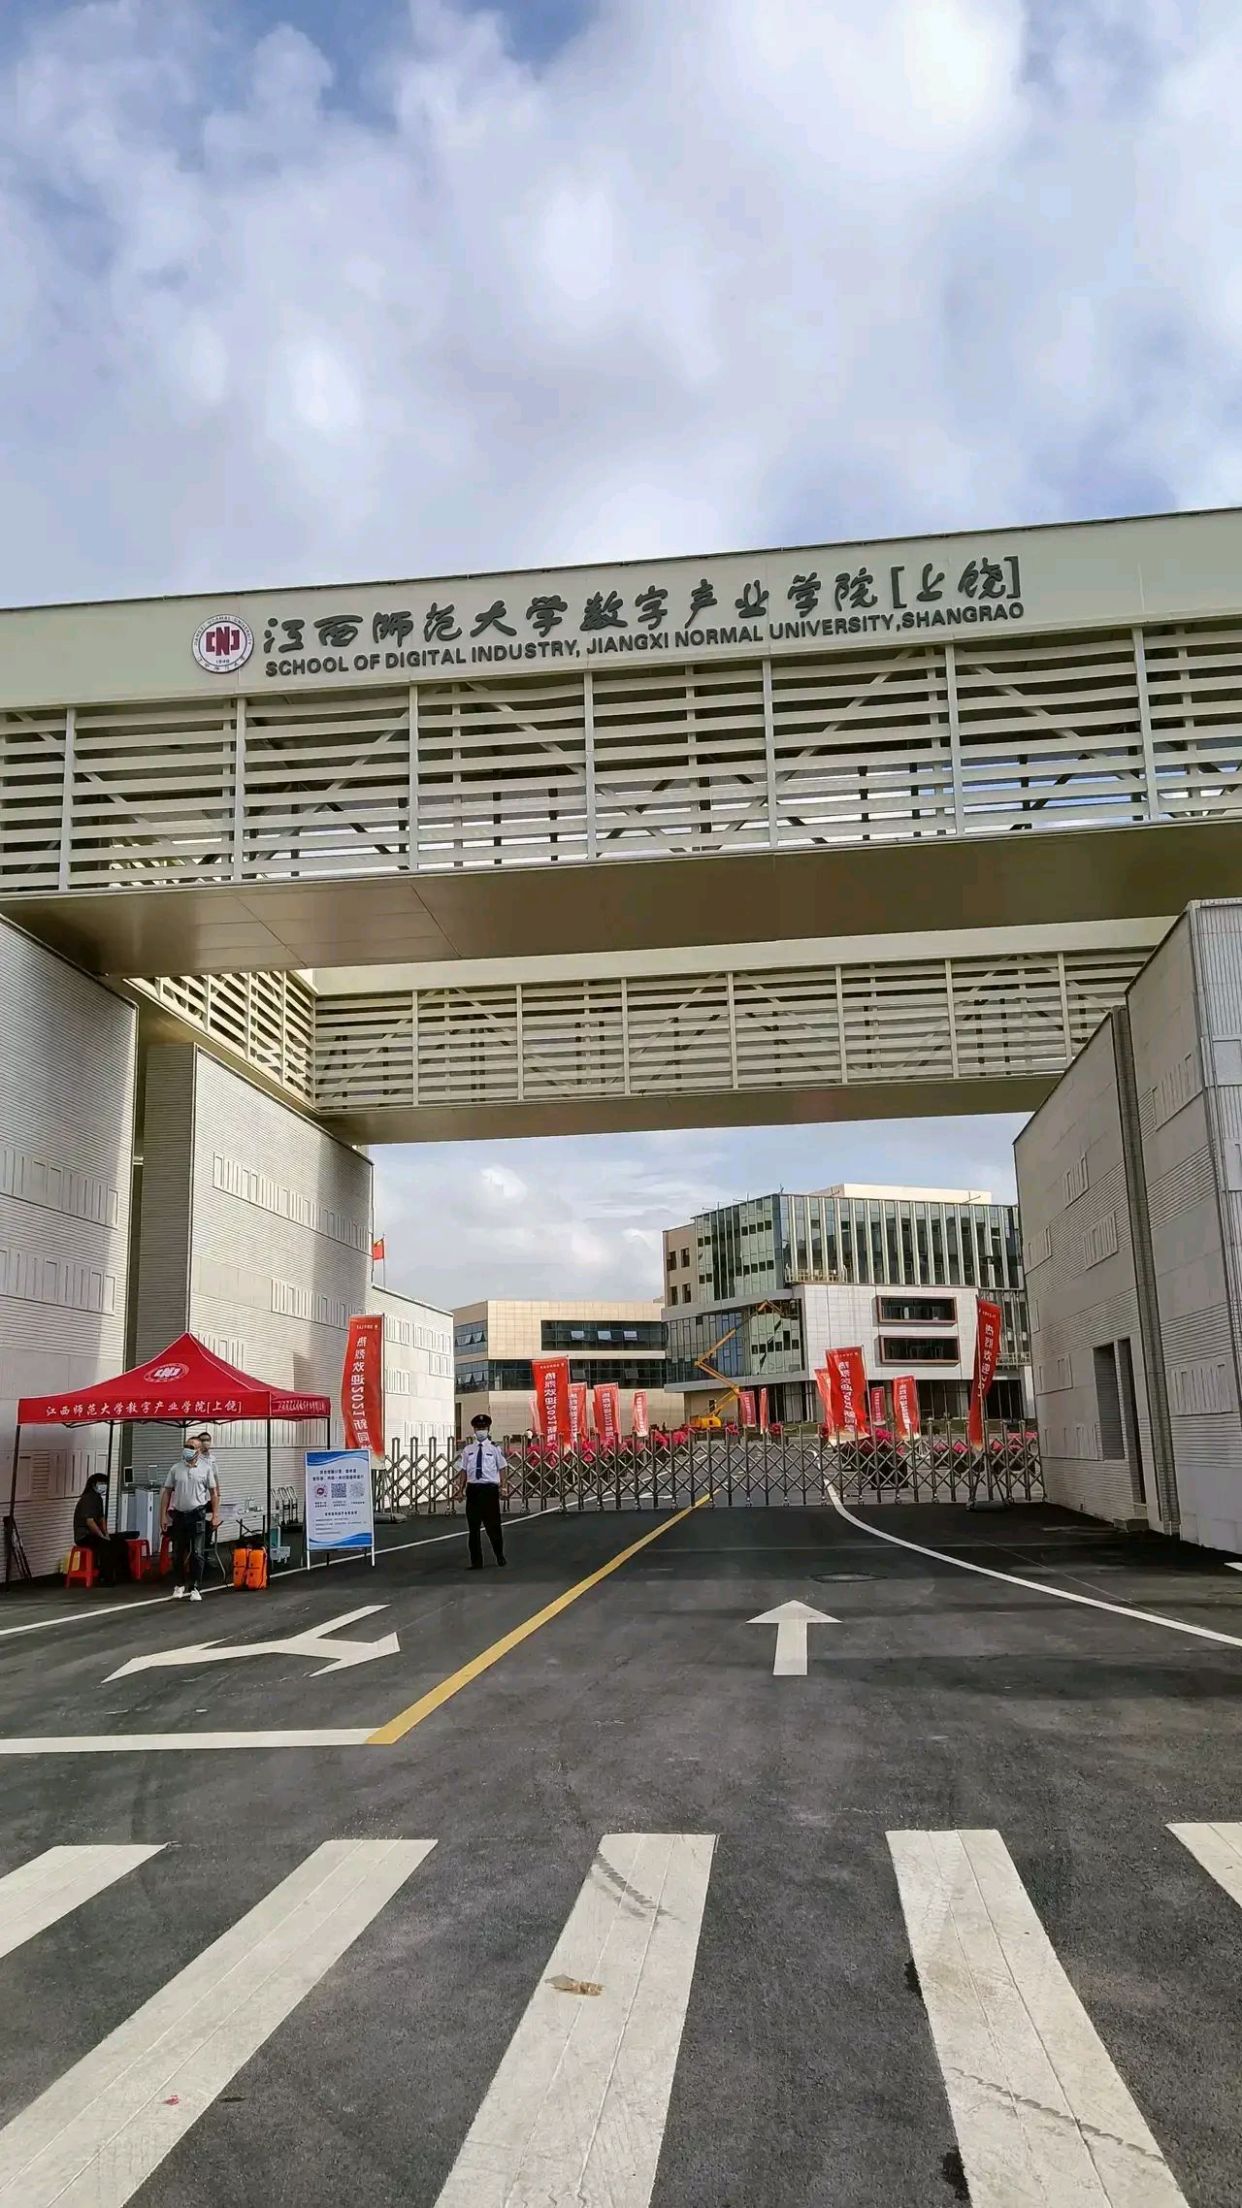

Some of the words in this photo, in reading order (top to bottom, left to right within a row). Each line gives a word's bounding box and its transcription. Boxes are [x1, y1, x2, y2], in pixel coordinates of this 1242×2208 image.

[265, 656, 349, 677] SCHOOL
[353, 653, 380, 671] OF
[385, 648, 466, 669] DIGITAL
[471, 639, 580, 663] INDUSTRY,
[586, 632, 669, 655] JIANGXI
[675, 625, 763, 647] NORMAL
